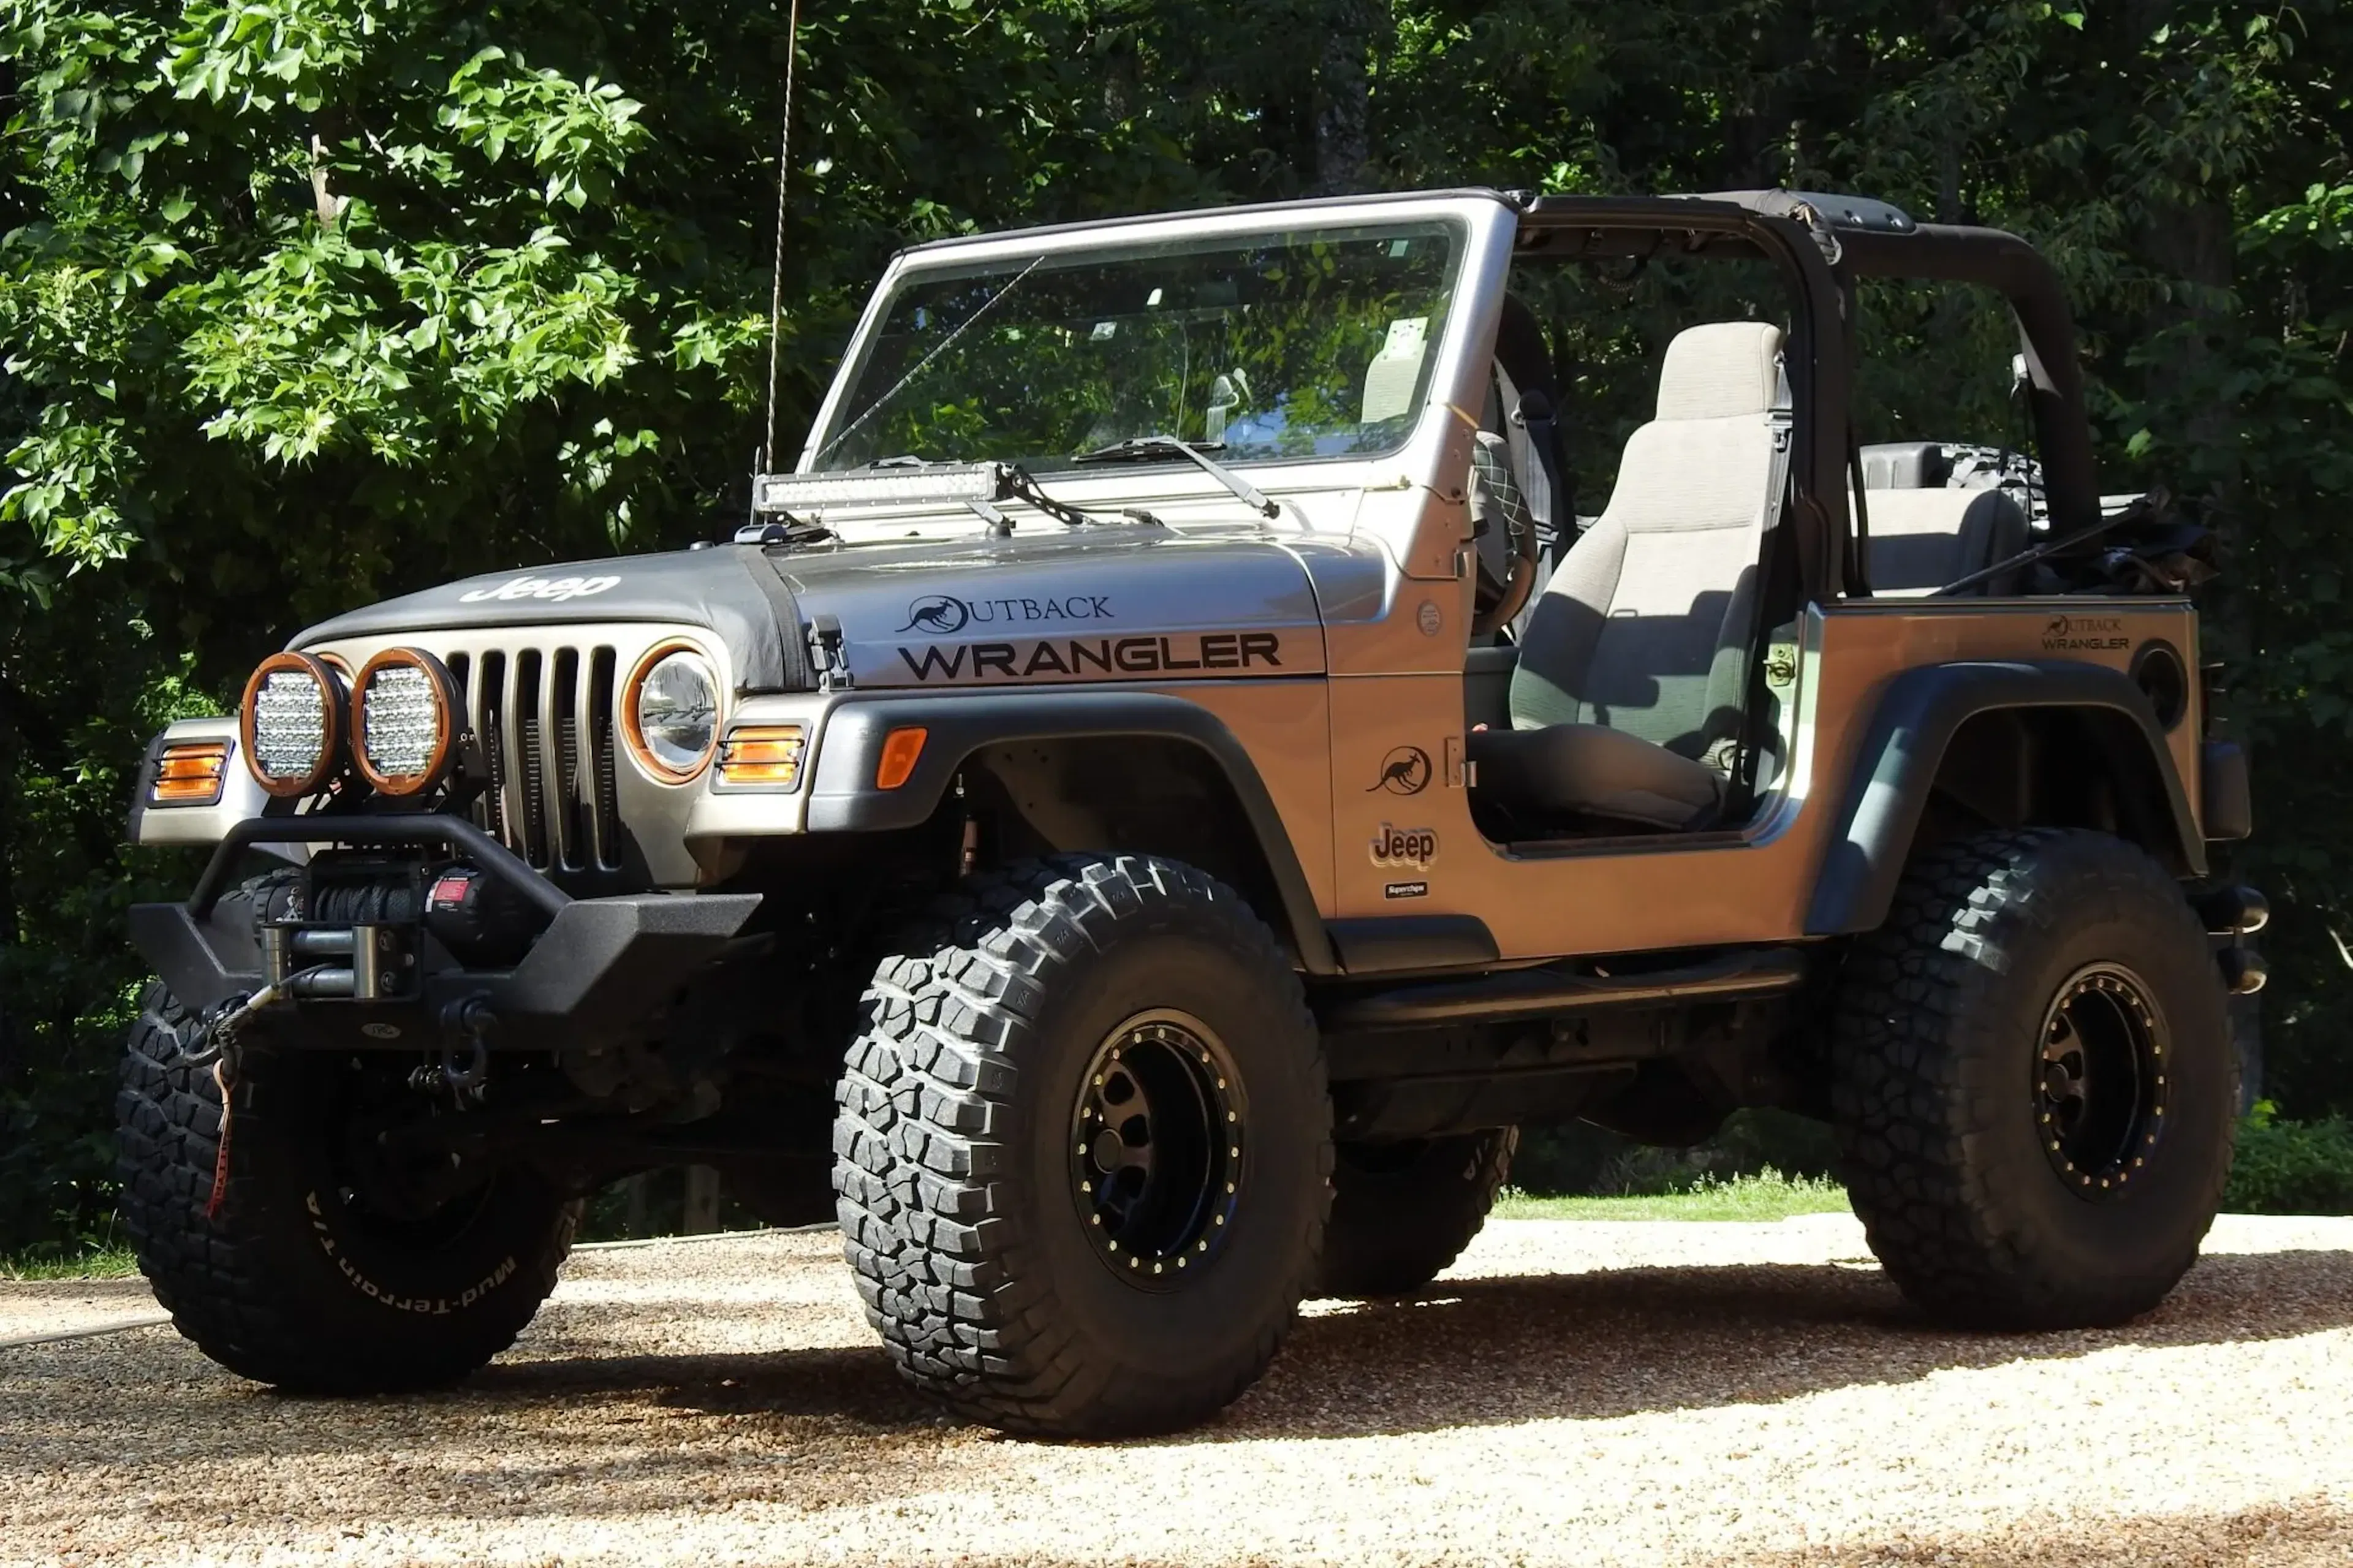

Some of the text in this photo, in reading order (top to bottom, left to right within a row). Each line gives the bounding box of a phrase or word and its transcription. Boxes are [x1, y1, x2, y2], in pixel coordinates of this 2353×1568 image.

[460, 575, 621, 602] Jeep
[897, 632, 1283, 681] WRANGLER
[2041, 638, 2130, 650] WRANGLER
[1374, 828, 1434, 863] Jeep
[338, 1255, 517, 1316] Mud-Terrain
